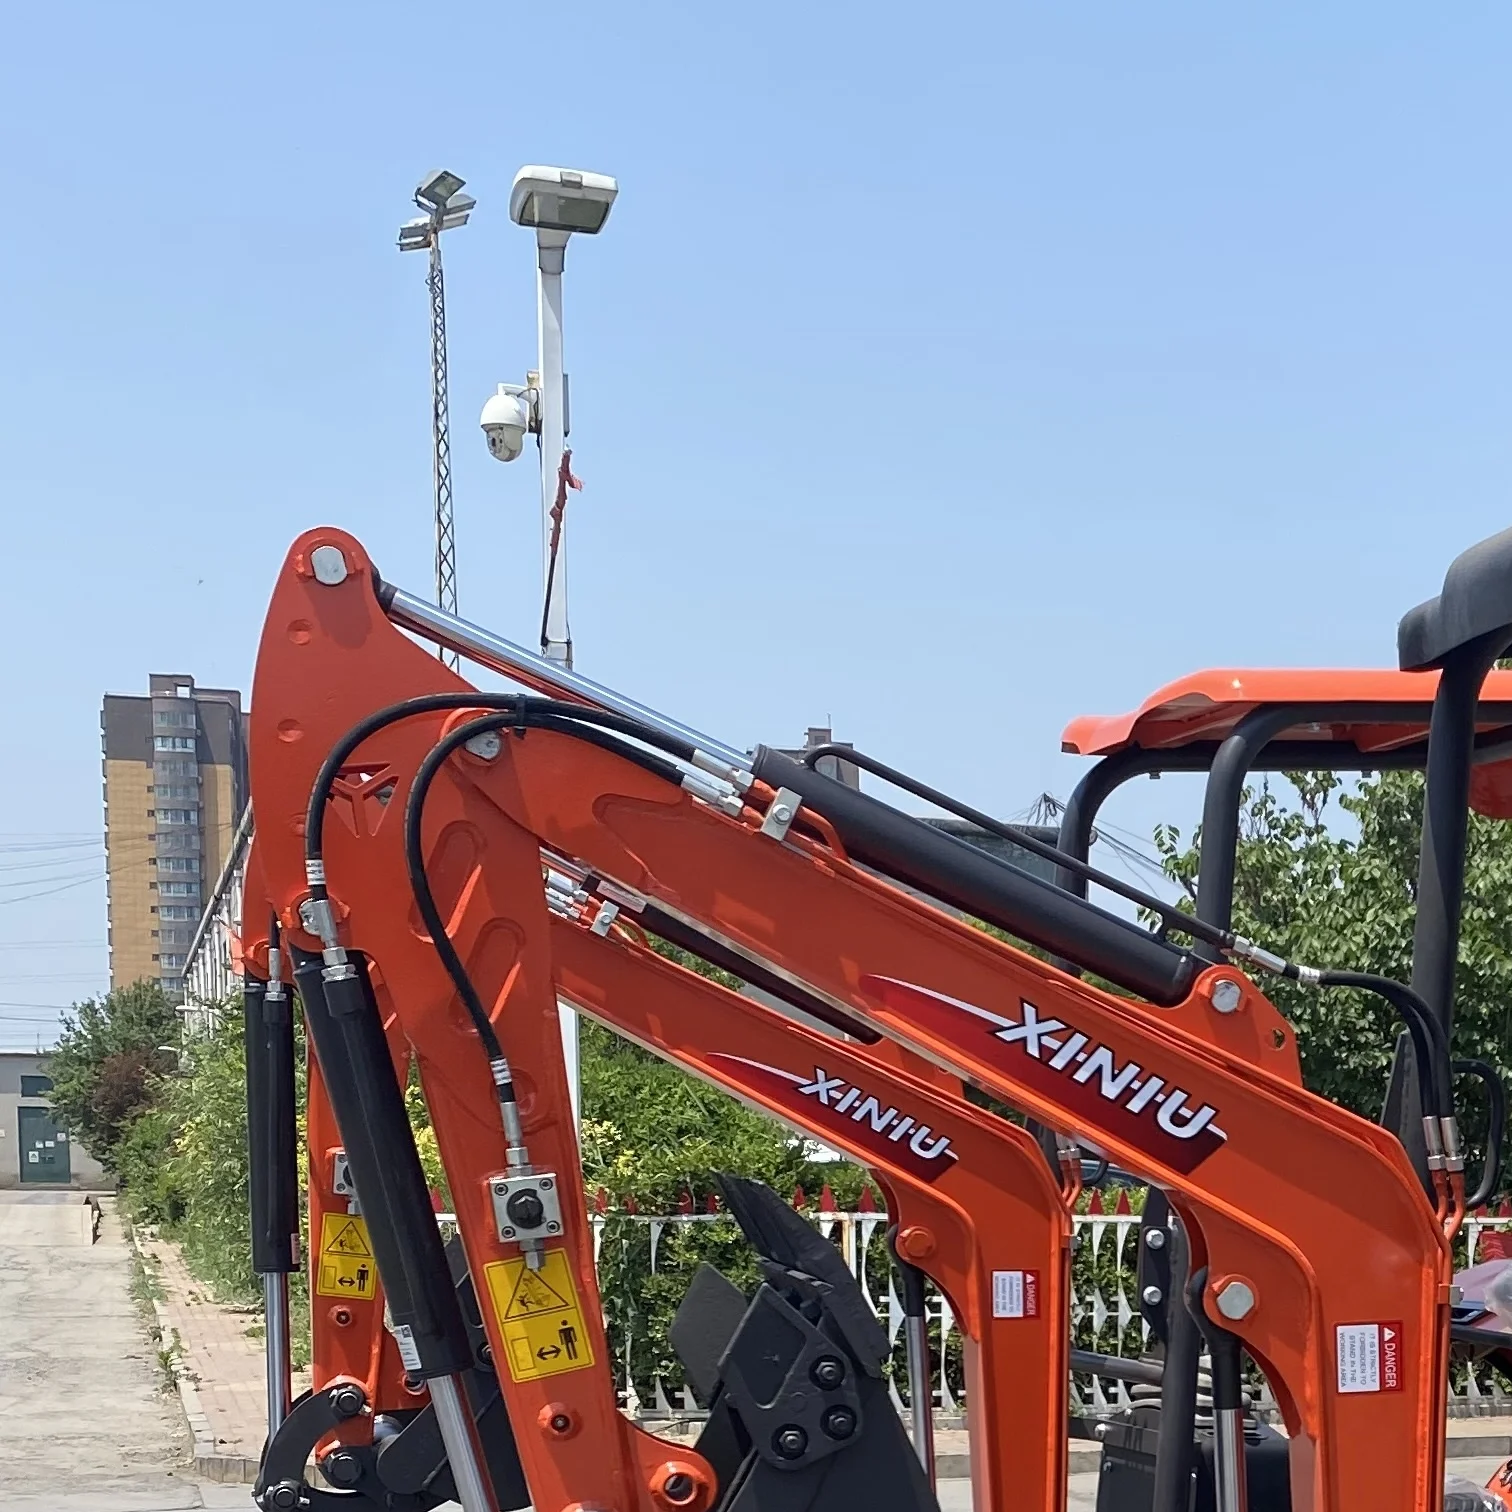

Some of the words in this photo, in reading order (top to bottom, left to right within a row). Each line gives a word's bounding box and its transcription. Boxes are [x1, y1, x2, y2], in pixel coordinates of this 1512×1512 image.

[796, 1066, 952, 1161] XINIU
[992, 1000, 1219, 1141] XINIU
[1384, 1342, 1397, 1388] DANGER
